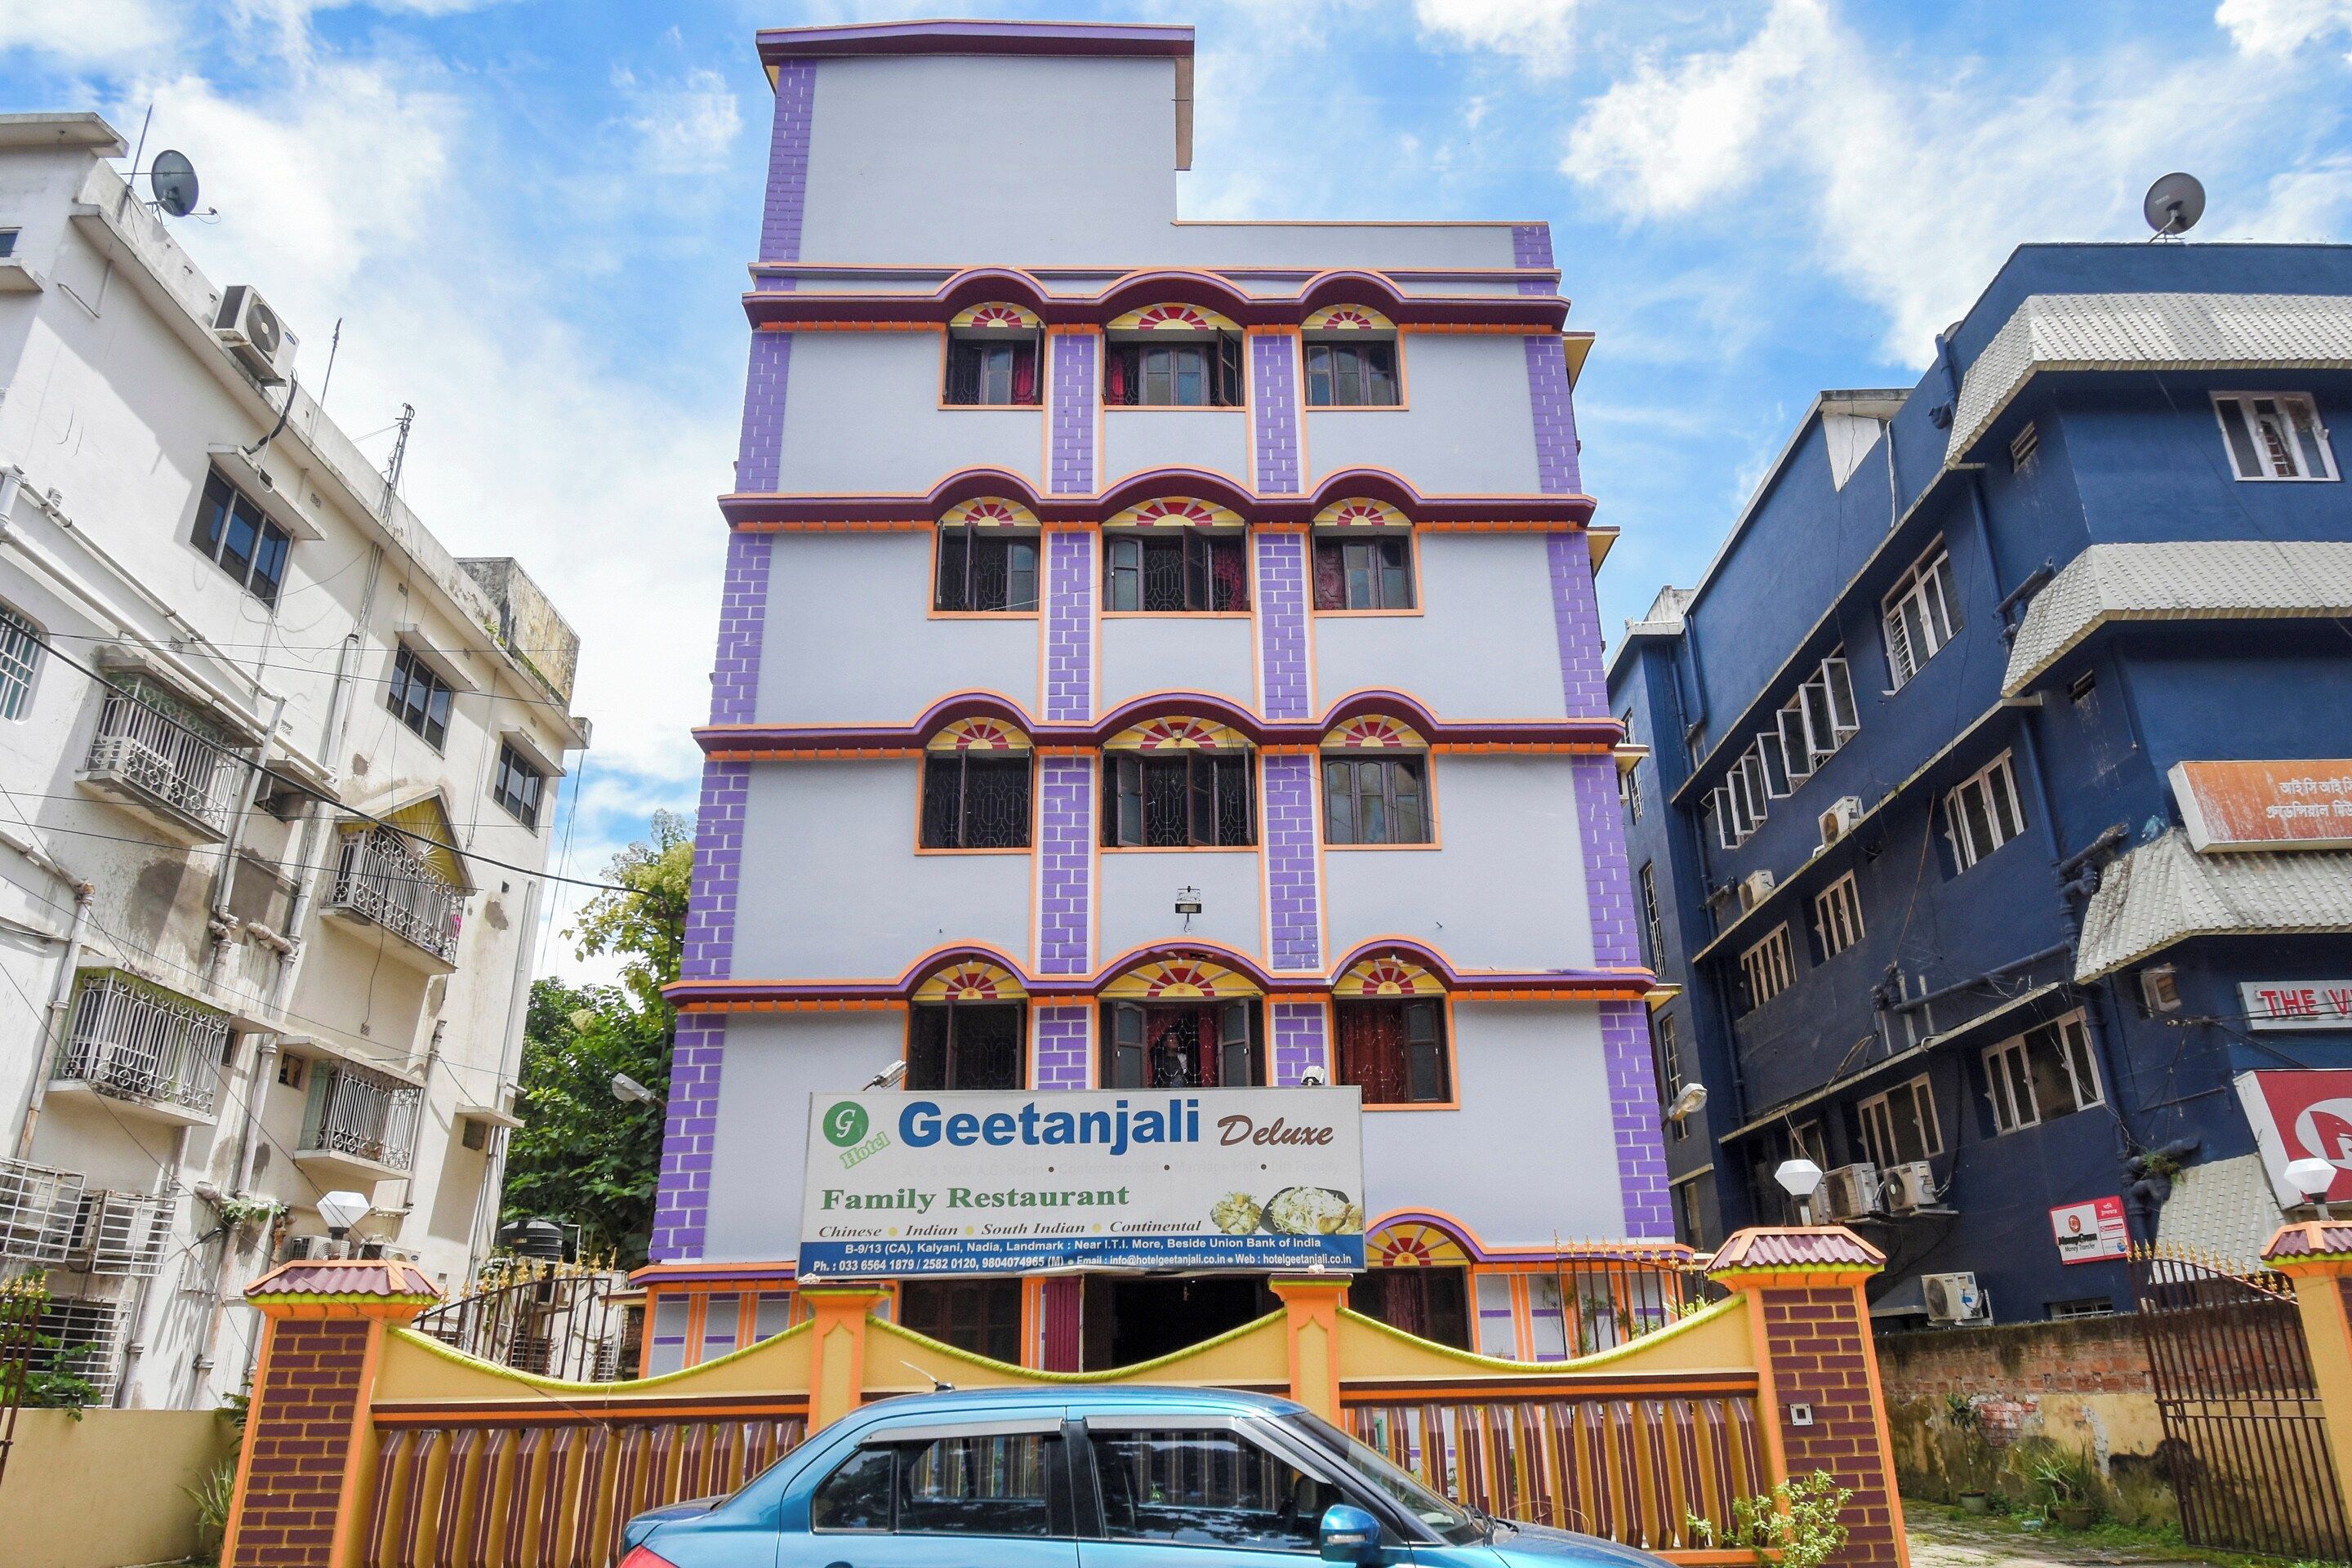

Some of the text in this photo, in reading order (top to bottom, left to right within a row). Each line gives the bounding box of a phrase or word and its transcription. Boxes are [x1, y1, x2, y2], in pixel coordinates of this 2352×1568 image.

[2258, 988, 2352, 1019] THE V
[835, 1108, 856, 1138] G
[898, 1098, 1334, 1156] Geetanjali Deluxe
[838, 1131, 892, 1170] Hotel
[820, 1186, 1130, 1214] Family Restaurant
[818, 1220, 1201, 1238] Chinese Indian South Indian Continental
[844, 1244, 881, 1254] B-9/13
[884, 1243, 914, 1255] (CA),
[917, 1243, 963, 1254] Kalyani,
[967, 1242, 1003, 1253] Nadia,
[1006, 1241, 1064, 1251] Landmark
[1075, 1240, 1101, 1250] Near
[1104, 1239, 1129, 1250] I.T.I.
[1132, 1239, 1164, 1250] More,
[1168, 1238, 1206, 1248] Beside
[1209, 1238, 1243, 1248] Union
[1246, 1238, 1276, 1248] Bank
[1278, 1238, 1290, 1247] of
[1293, 1238, 1321, 1248] India
[839, 1260, 859, 1271] 033
[861, 1259, 886, 1271] 6564
[889, 1258, 915, 1270] 1879
[923, 1258, 948, 1269] 2582
[951, 1258, 979, 1271] 0120,
[982, 1256, 1045, 1267] 9804074965
[1047, 1256, 1064, 1267] (M)
[1076, 1255, 1102, 1265] Email
[1109, 1254, 1226, 1266] info@hotelgeetanjali.co.in
[1235, 1254, 1256, 1264] Web
[1263, 1253, 1352, 1266] hotelgeetanjali.co.in
